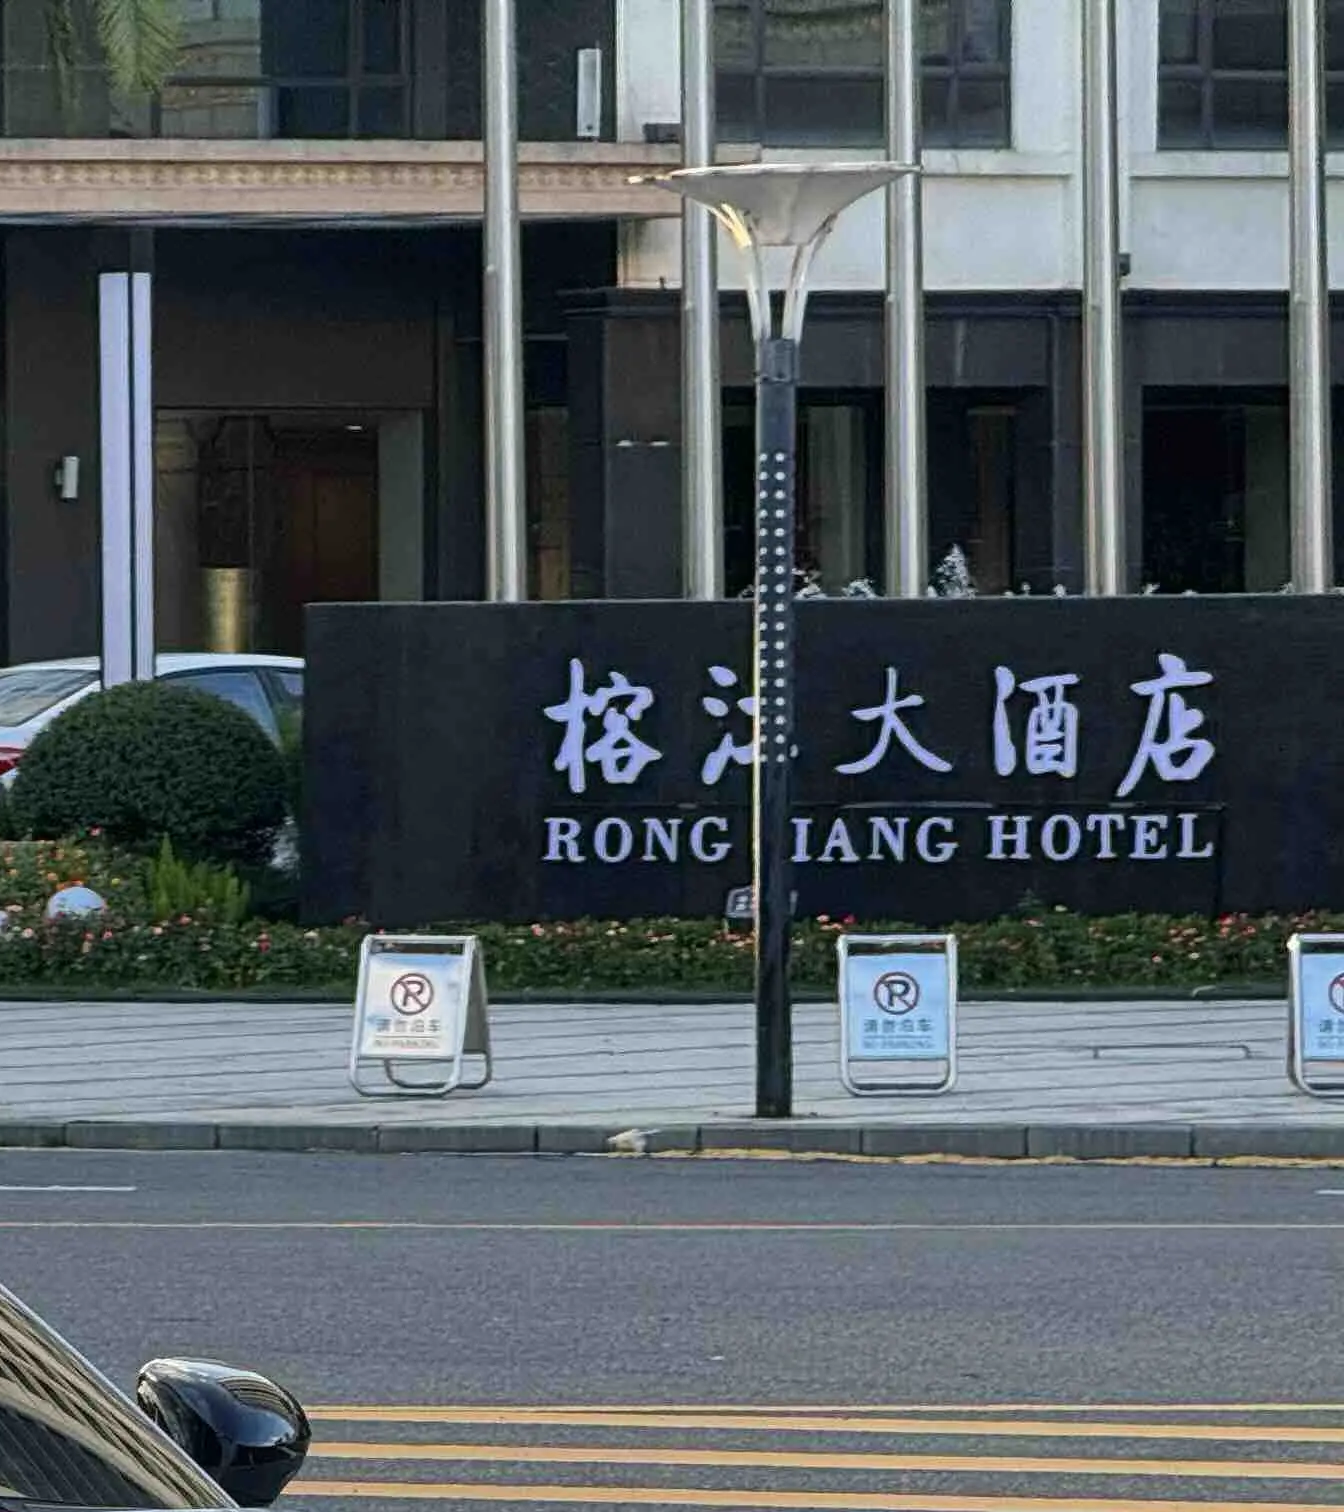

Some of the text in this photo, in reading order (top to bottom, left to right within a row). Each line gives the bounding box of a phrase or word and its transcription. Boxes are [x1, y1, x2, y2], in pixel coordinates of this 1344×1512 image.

[541, 813, 1214, 863] RONG IANG HOTEL
